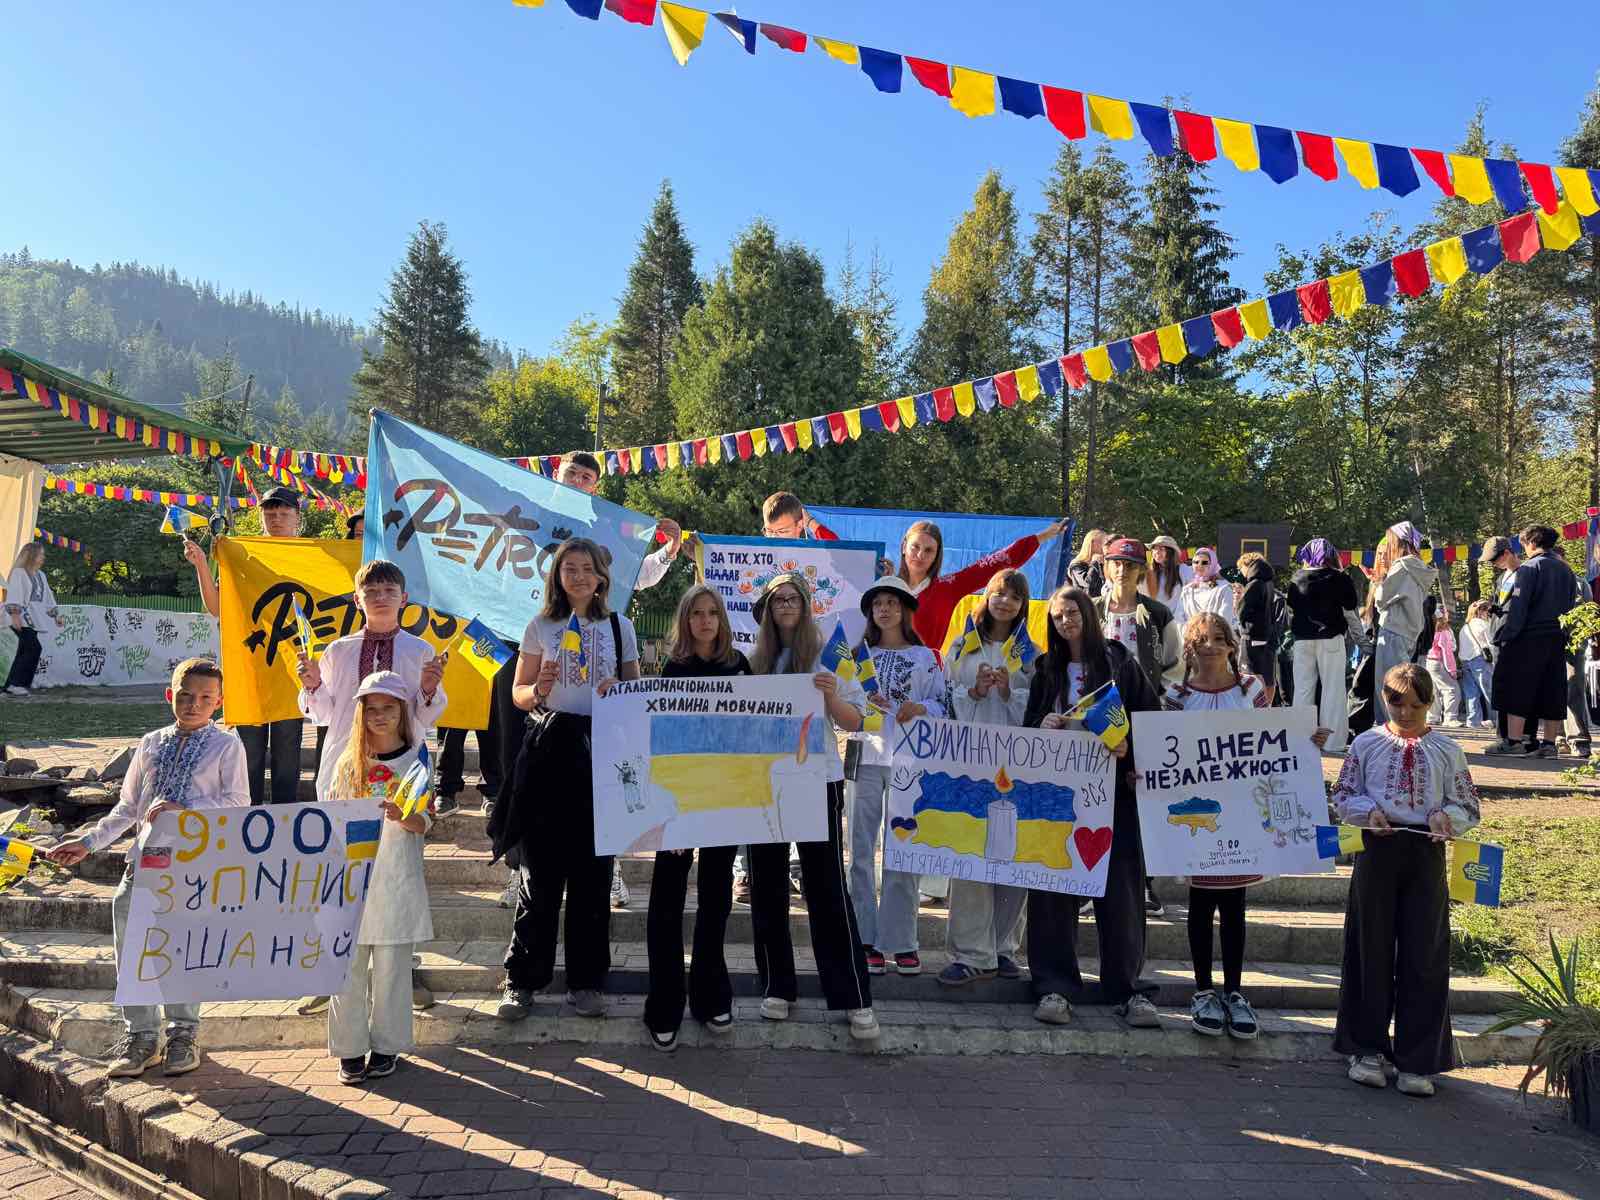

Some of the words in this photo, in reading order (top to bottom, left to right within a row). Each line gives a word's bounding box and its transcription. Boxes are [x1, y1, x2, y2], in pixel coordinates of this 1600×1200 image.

[710, 551, 725, 564] ЗА
[753, 552, 774, 565] ХТО
[645, 698, 710, 713] ХВИЛИНА
[715, 699, 793, 716] МОВЧАННЯ
[1162, 735, 1180, 768] З
[1196, 728, 1289, 765] ДНЕМ
[1145, 755, 1299, 791] НЕЗАЛЕЖНОСТІ
[175, 807, 332, 863] 9:00
